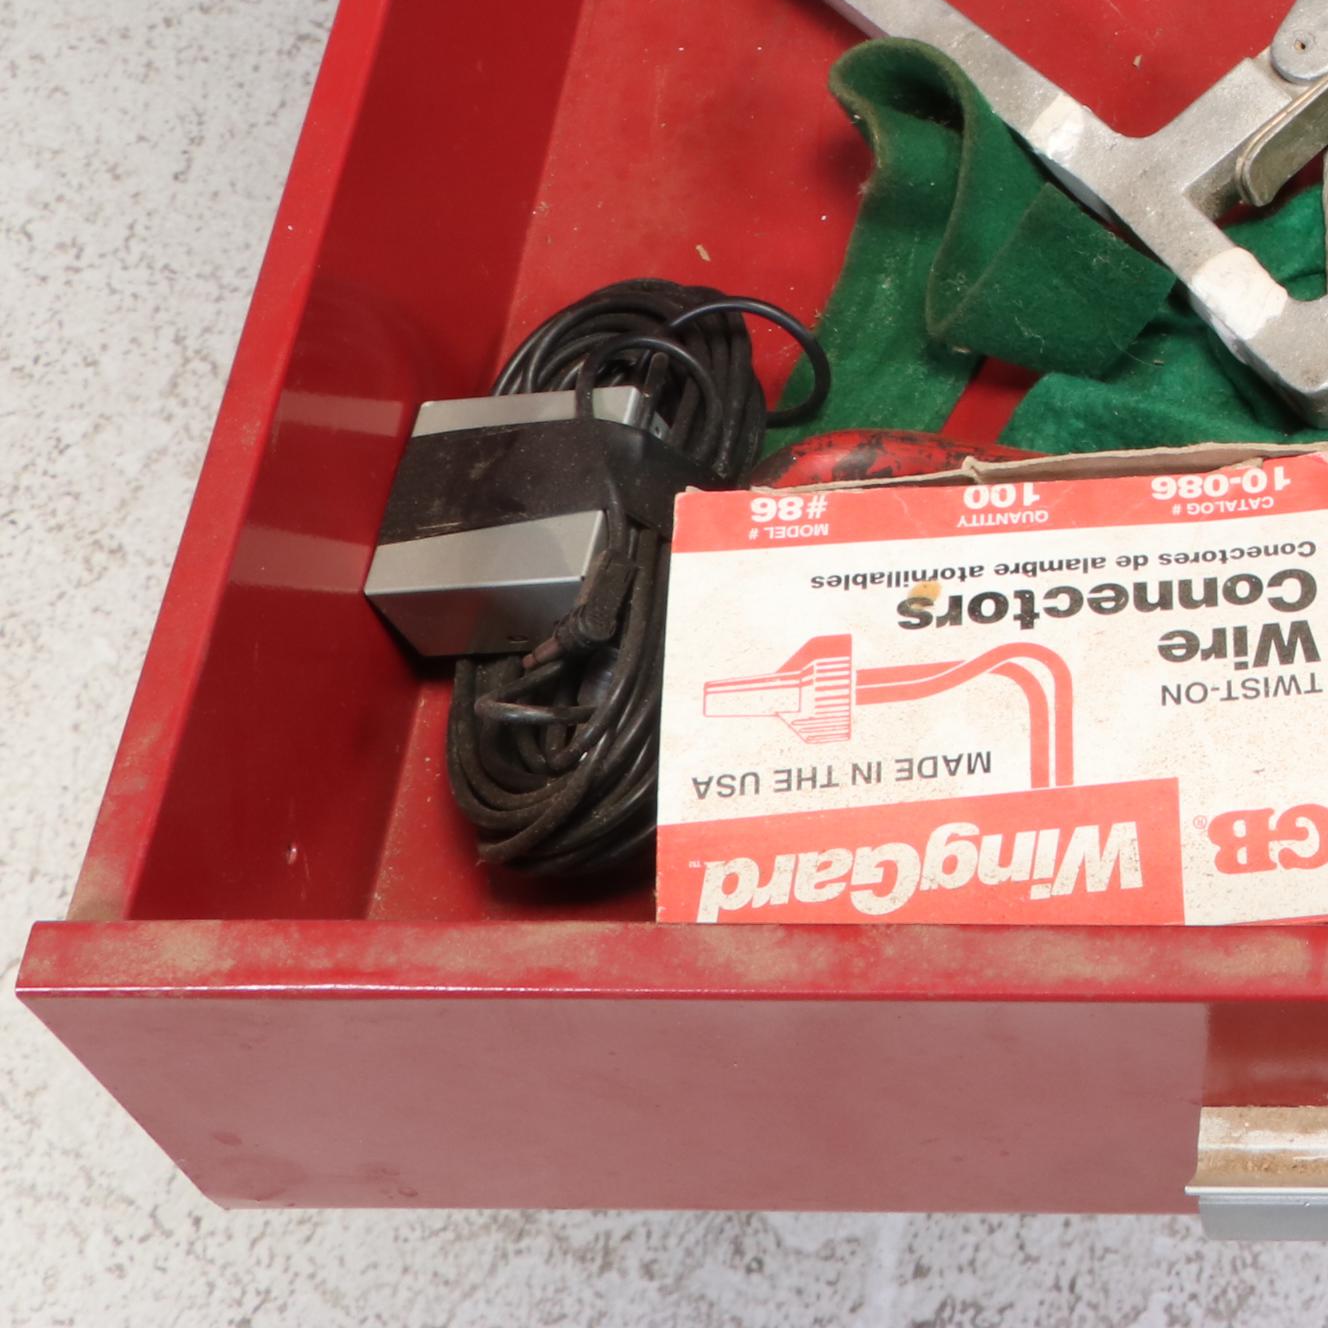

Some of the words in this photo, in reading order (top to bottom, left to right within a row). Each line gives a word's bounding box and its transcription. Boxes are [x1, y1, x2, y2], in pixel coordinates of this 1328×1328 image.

[962, 482, 1040, 510] 100
[1151, 465, 1291, 500] 10-086
[750, 495, 827, 522] #86
[956, 509, 1048, 528] QUANTITY
[1187, 496, 1274, 515] CATALOG
[764, 522, 829, 539] MODEL
[1115, 554, 1149, 571] de
[1158, 540, 1317, 566] Conectores
[810, 564, 984, 591] atornillables
[994, 556, 1106, 578] alambre
[896, 568, 1317, 630] Connectors
[1157, 619, 1321, 671] Wire
[1160, 672, 1323, 706] TWIST-ON
[773, 764, 839, 793] THE
[851, 761, 882, 786] IN
[895, 751, 992, 782] MADE
[692, 771, 760, 800] USA
[696, 820, 1144, 923] WingGard
